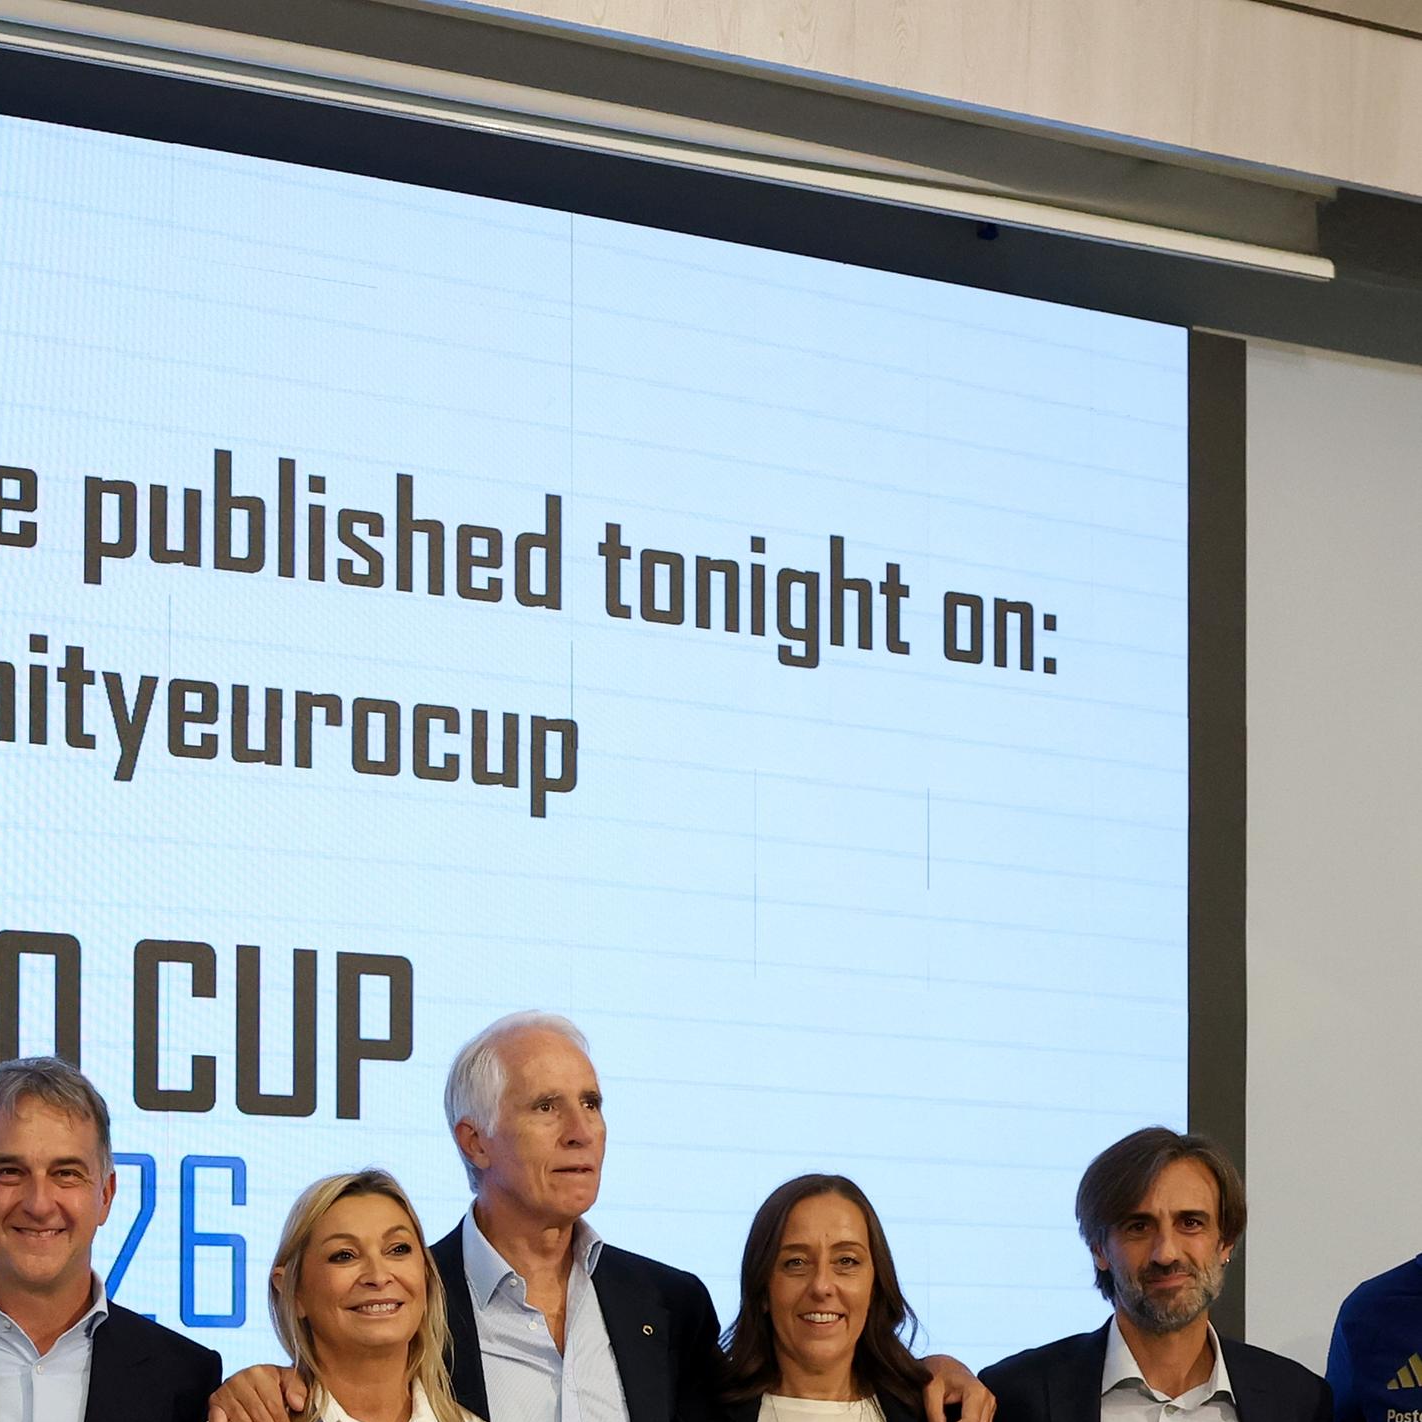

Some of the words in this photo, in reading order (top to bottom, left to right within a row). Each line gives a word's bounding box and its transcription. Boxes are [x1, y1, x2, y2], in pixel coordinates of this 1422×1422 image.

[84, 449, 562, 585] published
[599, 523, 910, 669] tonight
[943, 590, 1057, 675] on:
[133, 939, 413, 1120] CUP
